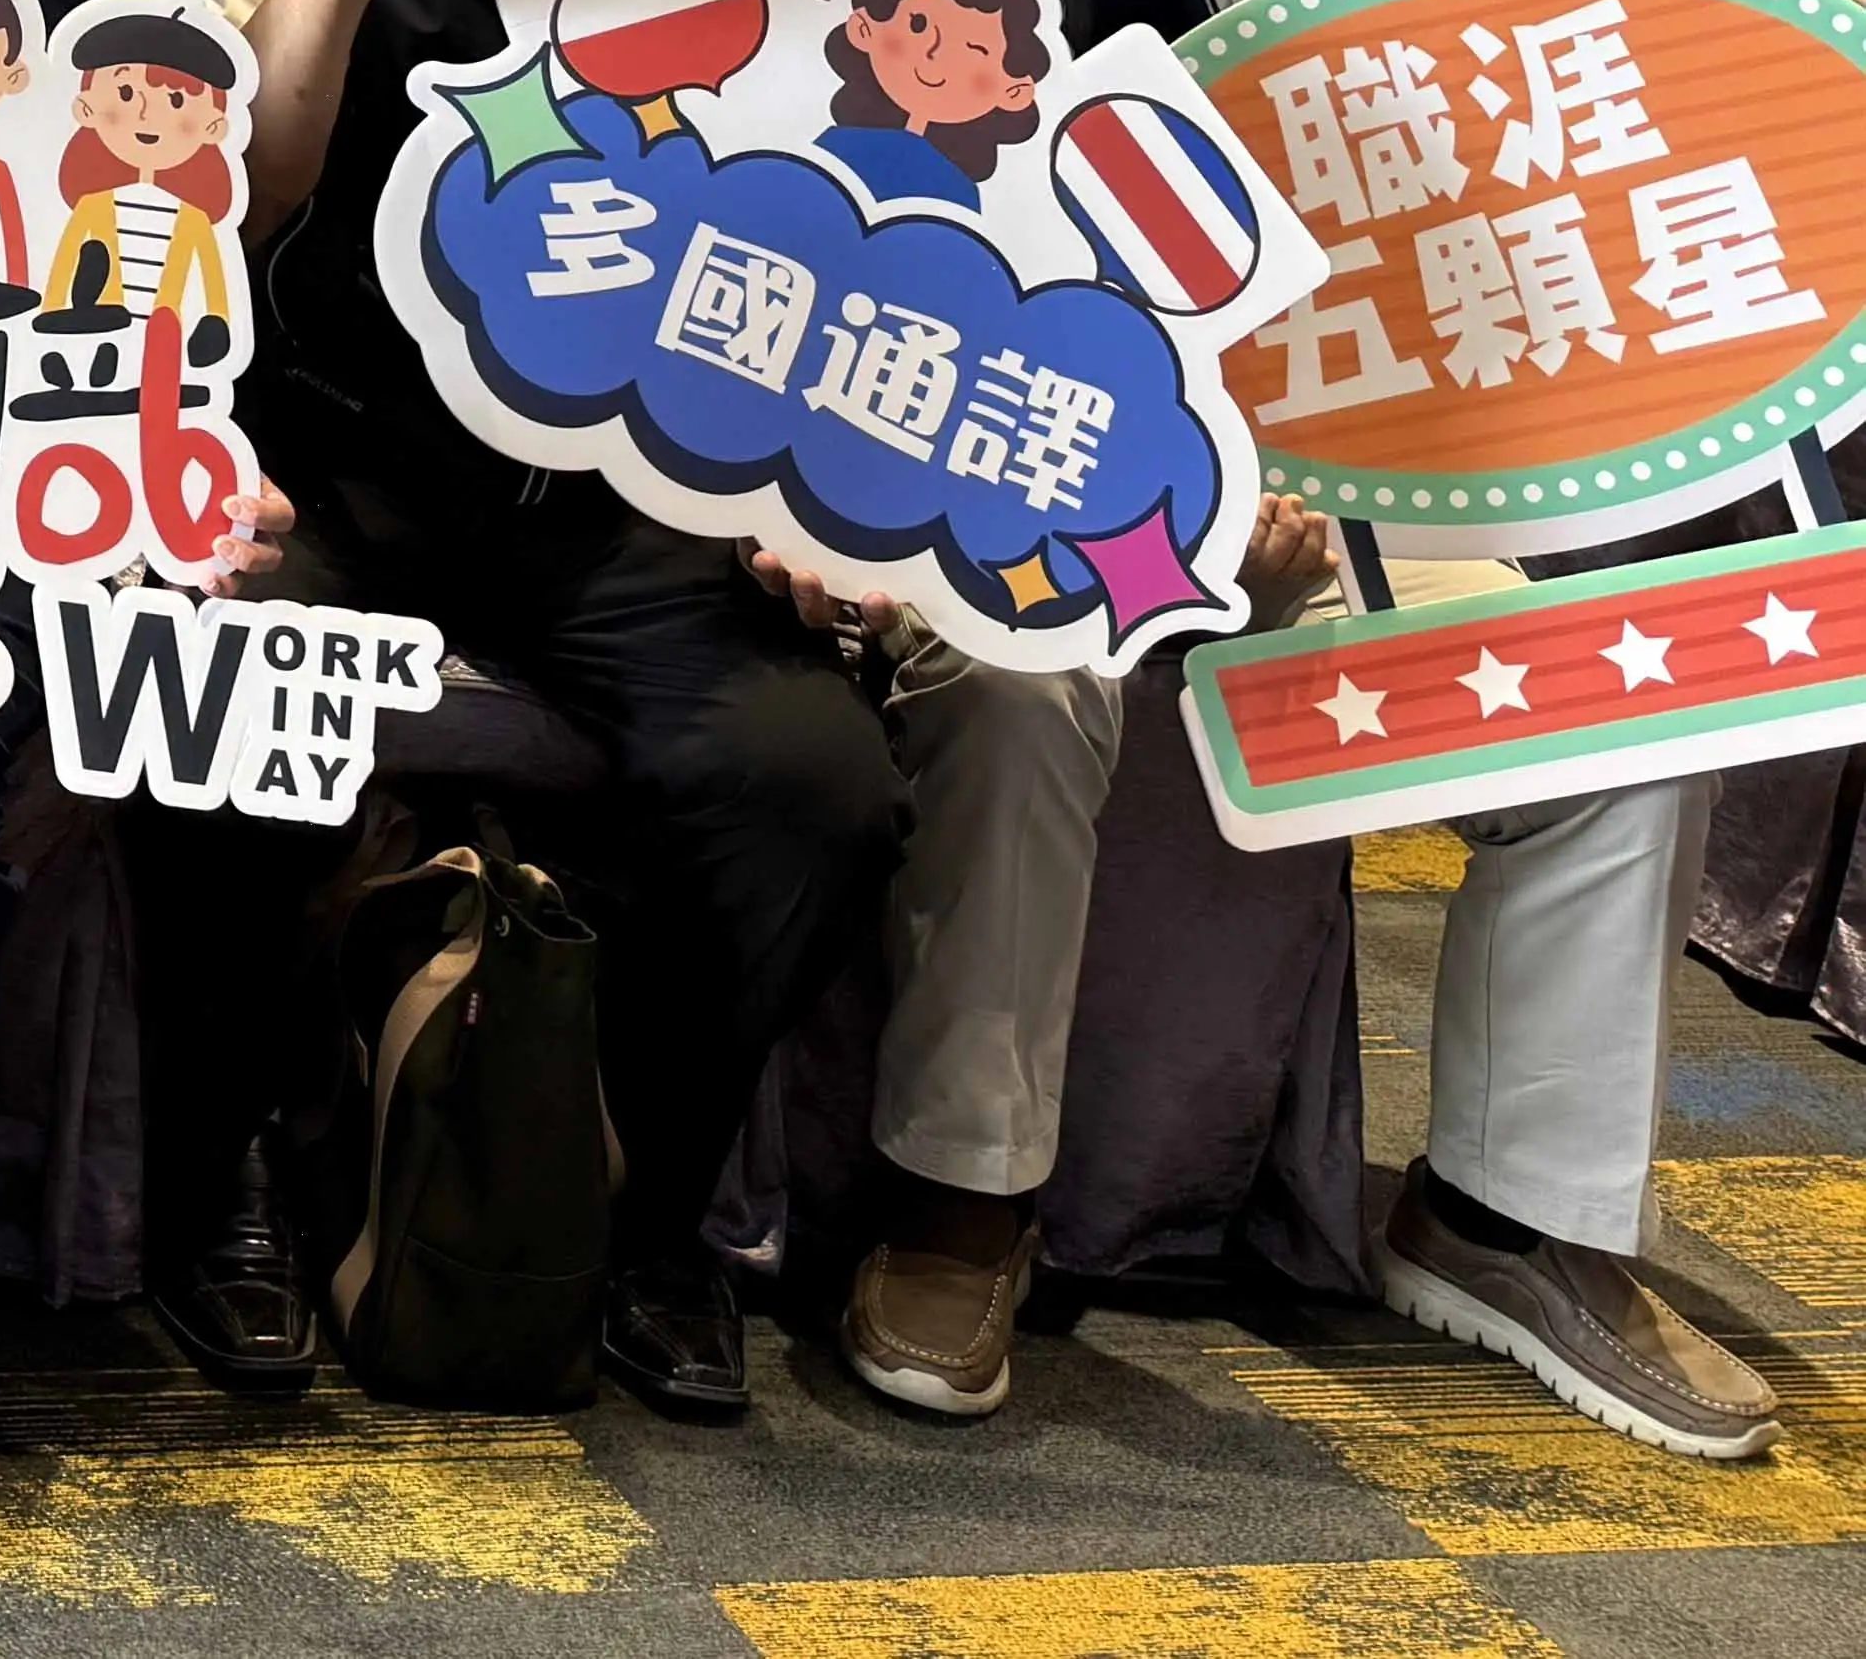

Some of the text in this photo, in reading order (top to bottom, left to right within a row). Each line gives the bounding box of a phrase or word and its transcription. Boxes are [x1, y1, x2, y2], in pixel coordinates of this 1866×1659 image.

[526, 177, 1115, 515] 多國通譯
[1253, 156, 1828, 427] 五顆星
[272, 697, 351, 742] IN
